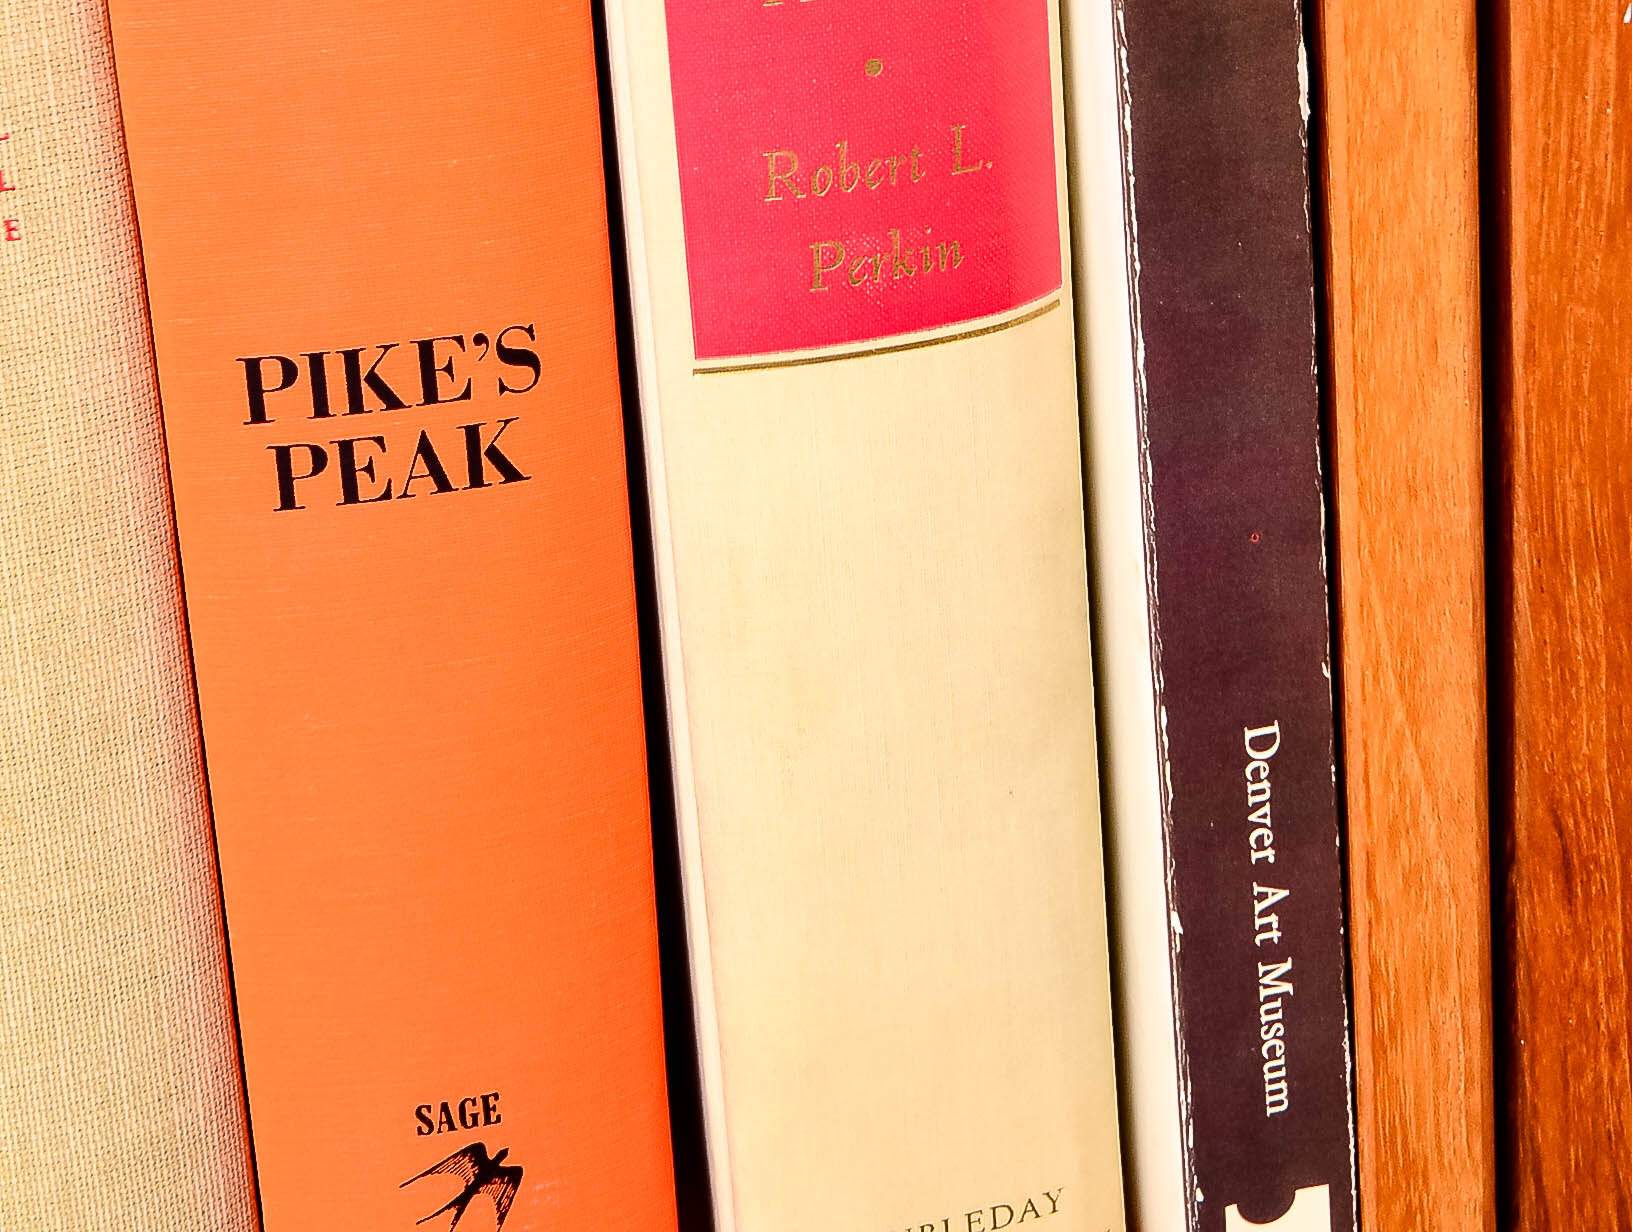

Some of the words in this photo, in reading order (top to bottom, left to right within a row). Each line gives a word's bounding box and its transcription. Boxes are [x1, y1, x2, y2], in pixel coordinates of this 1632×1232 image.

[763, 139, 925, 204] Robert
[950, 123, 995, 177] L.
[808, 229, 966, 294] Perkin
[235, 323, 542, 425] PIKE'S
[266, 417, 532, 512] PEAK
[1243, 719, 1281, 865] Denver
[1252, 881, 1290, 947] Art
[1257, 956, 1294, 1118] Museum
[415, 1091, 502, 1136] SAGE
